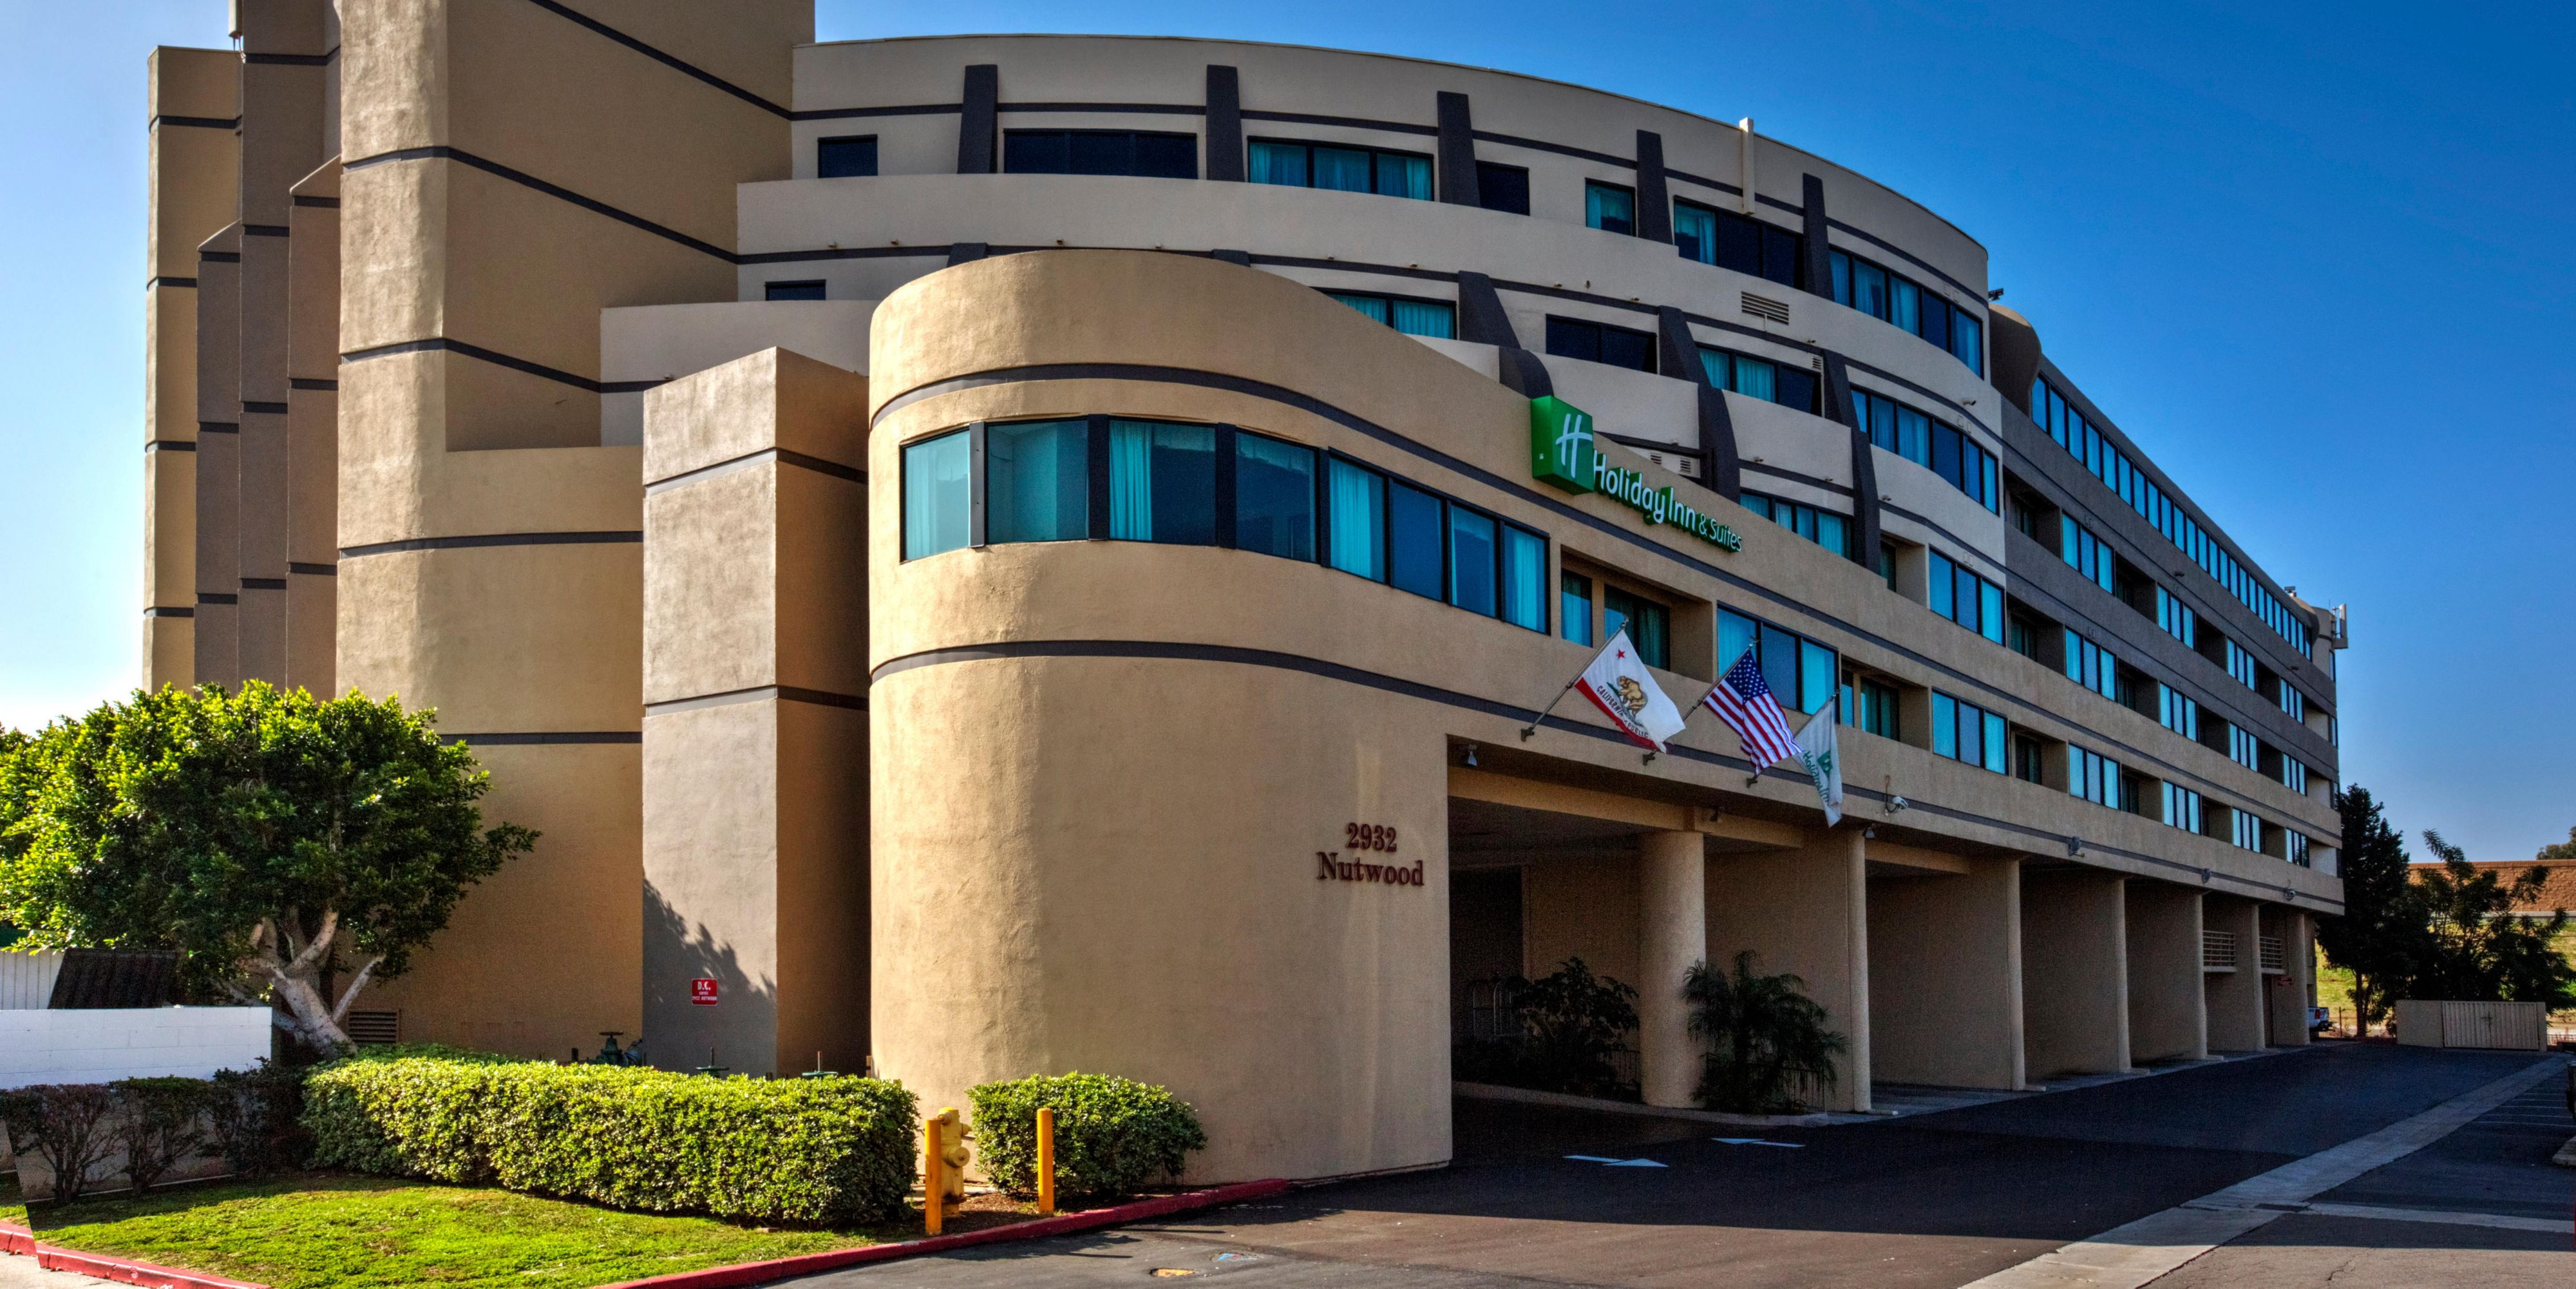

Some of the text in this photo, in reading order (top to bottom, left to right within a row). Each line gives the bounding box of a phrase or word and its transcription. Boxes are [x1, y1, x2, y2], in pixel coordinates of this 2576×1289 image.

[1593, 449, 1743, 552] Holiday Inn & Suites
[1597, 685, 1649, 738] CALIFORNIA PUBLIC
[1346, 822, 1397, 852] 2932
[1316, 852, 1425, 886] Nutwood
[697, 981, 711, 990] D.C.
